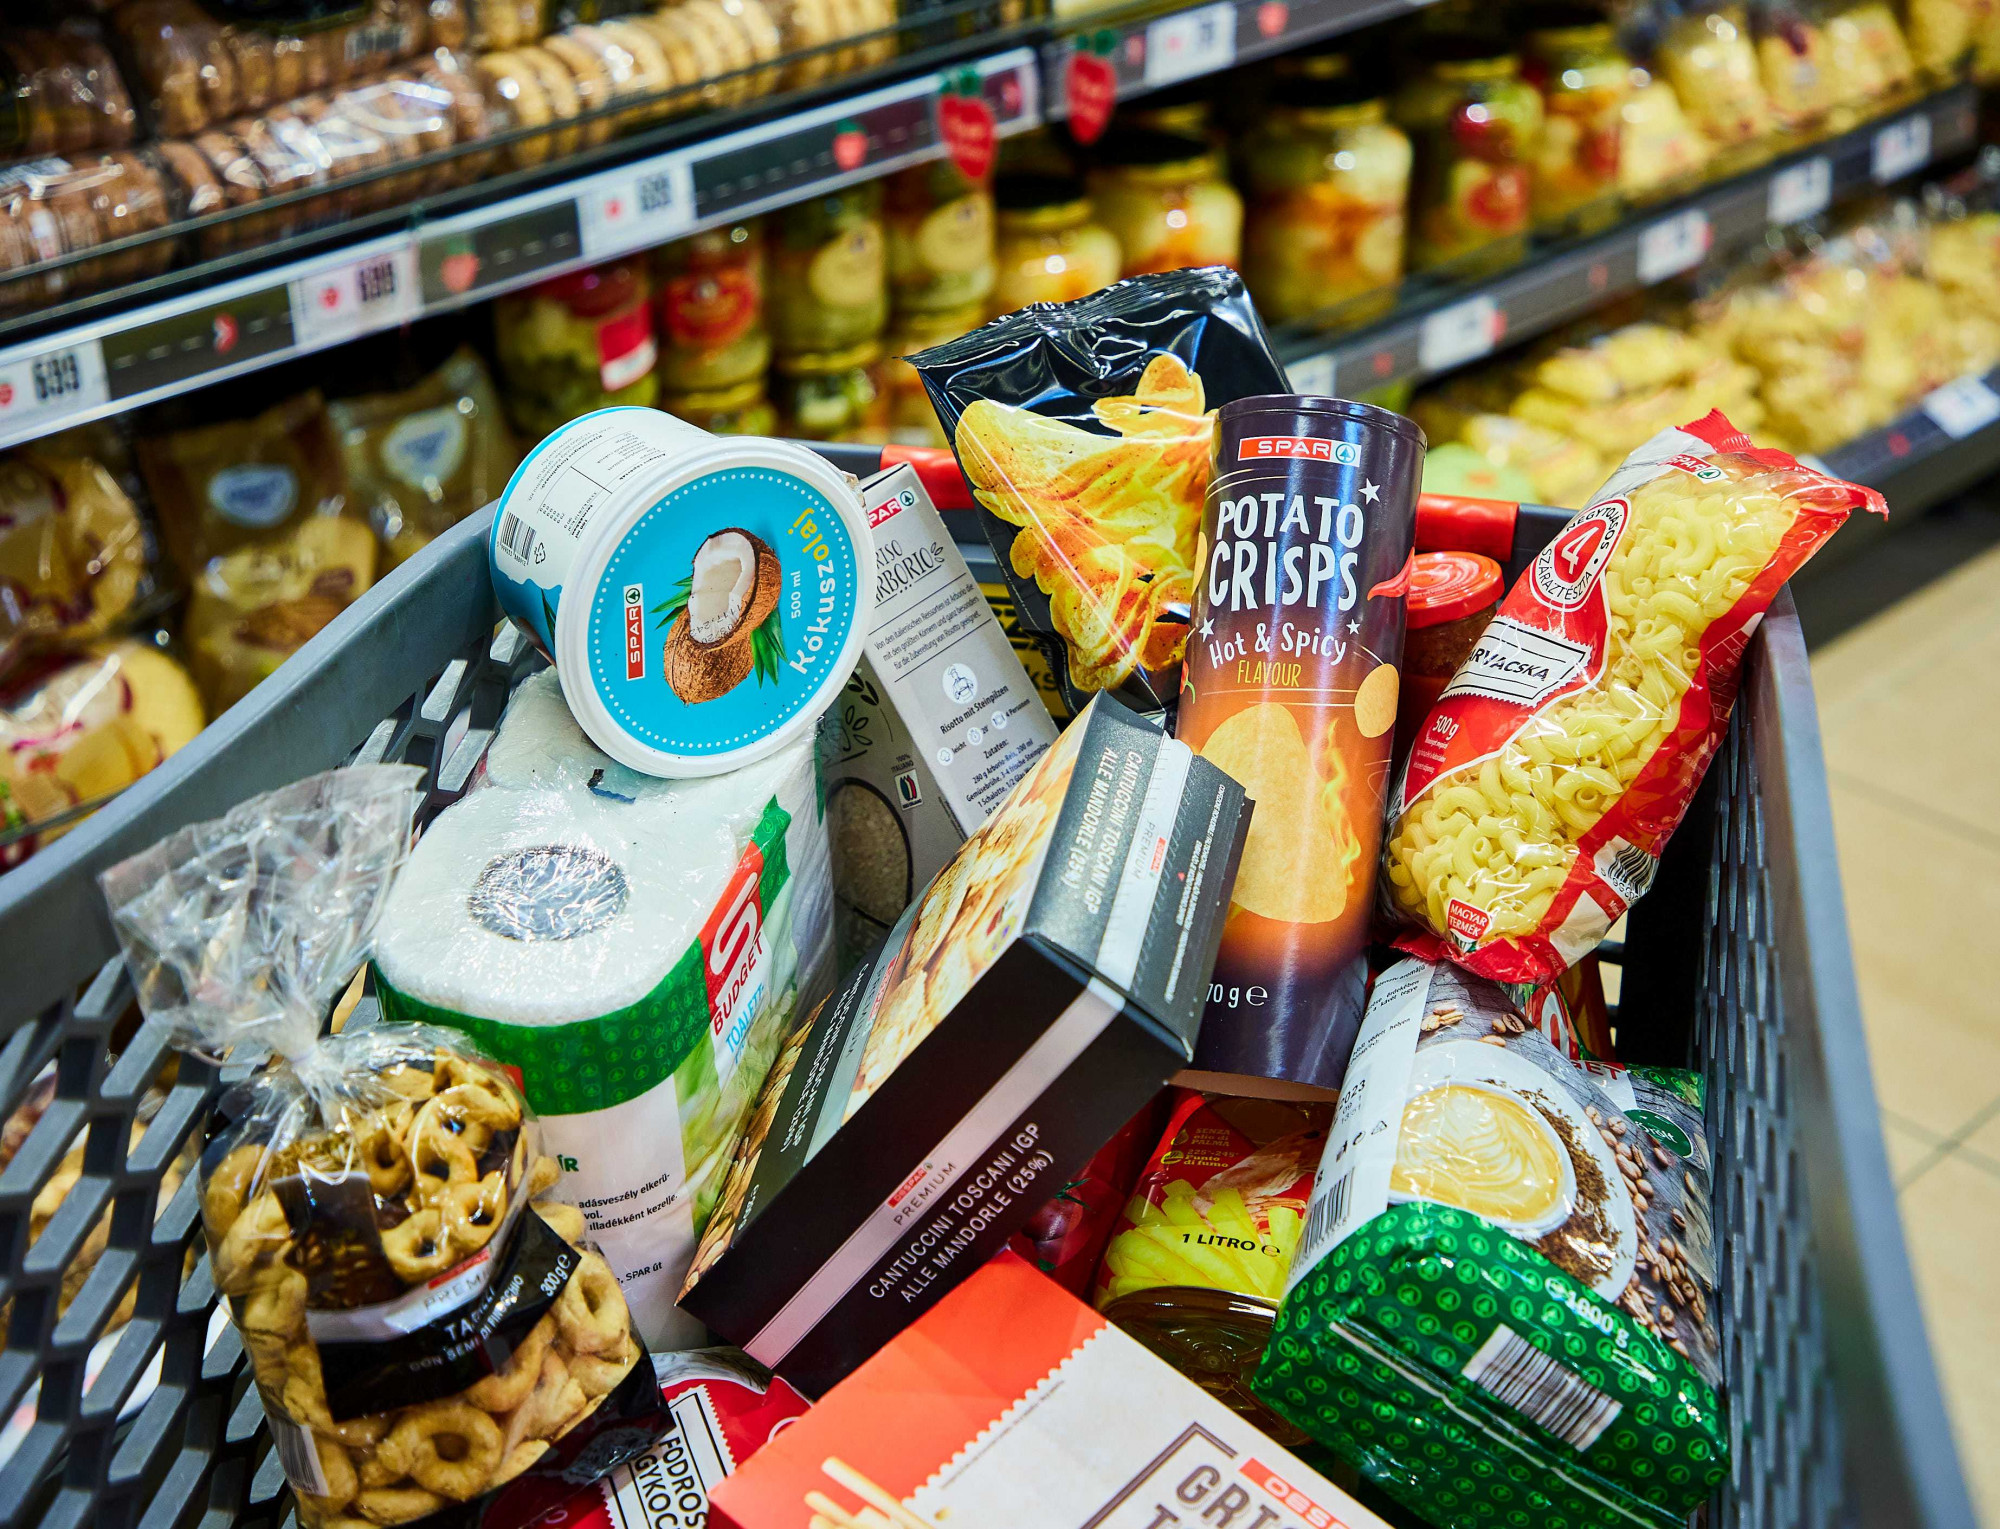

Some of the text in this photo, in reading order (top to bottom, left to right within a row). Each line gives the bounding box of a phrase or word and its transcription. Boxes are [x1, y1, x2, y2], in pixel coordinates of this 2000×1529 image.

[1257, 440, 1331, 457] SPAR
[1215, 493, 1364, 549] POTATO
[1538, 548, 1593, 601] SZÁRAZTÉSZTA
[1561, 526, 1600, 575] 4
[790, 570, 802, 619] 500 ml
[1208, 540, 1359, 612] CRISPS
[629, 606, 642, 664] SPAR
[874, 639, 885, 651] Von
[884, 634, 894, 644] den
[893, 616, 921, 638] italienischen
[921, 602, 945, 620] Reissorten
[950, 589, 965, 602] Arborio
[965, 583, 974, 592] die
[882, 652, 892, 662] mit
[891, 646, 901, 656] den
[901, 634, 920, 651] größten
[936, 617, 947, 627] und
[946, 610, 958, 622] ganz
[894, 660, 902, 670] für
[901, 656, 910, 665] die
[909, 639, 937, 661] Zubereitung
[935, 633, 946, 643] von
[945, 624, 959, 636] Risotto
[1208, 622, 1347, 669] Hot & Spicy
[1236, 658, 1302, 688] FLAVOUR
[940, 685, 1009, 734] Risotto mit Steinpilzen
[951, 741, 967, 754] leicht
[1009, 699, 1029, 715] Personen
[1432, 715, 1459, 741] 500 g
[982, 771, 988, 779] g
[1016, 743, 1027, 754] 200
[1025, 738, 1033, 747] ml
[984, 739, 1008, 759] Zutaten:
[1098, 747, 1119, 781] ALLE
[965, 775, 1002, 802] Gemüsebrühe,
[1010, 759, 1025, 772] frische
[981, 786, 1007, 805] Schalotte,
[1005, 778, 1016, 789] 1/2
[1075, 778, 1110, 850] MANDORLE
[1083, 751, 1143, 915] CANTUCCINI TOSCANI IGP
[1134, 821, 1156, 879] PREMIUM
[710, 871, 759, 976] S
[1449, 915, 1482, 937] TERMÉK
[1450, 904, 1488, 927] MAGYAR
[713, 931, 763, 1036] BUDGET
[1227, 986, 1240, 1009] g
[798, 1022, 836, 1106] MANDORLE
[801, 1047, 834, 1119] TOSCANI
[1191, 1139, 1231, 1147] PALMA
[1197, 1160, 1229, 1168] fumo
[646, 1194, 679, 1216] kezelje.
[869, 1122, 1039, 1299] CANTUCCINI TOSCANI IGP
[893, 1162, 957, 1226] PREMIUM
[900, 1149, 1054, 1303] ALLE MANDORLE (25%)
[1182, 1233, 1190, 1244] 1
[1197, 1234, 1256, 1252] LITRO
[626, 1266, 651, 1282] SPAR
[652, 1261, 664, 1274] út
[480, 1324, 492, 1341] DI
[658, 1436, 708, 1529] FODROS
